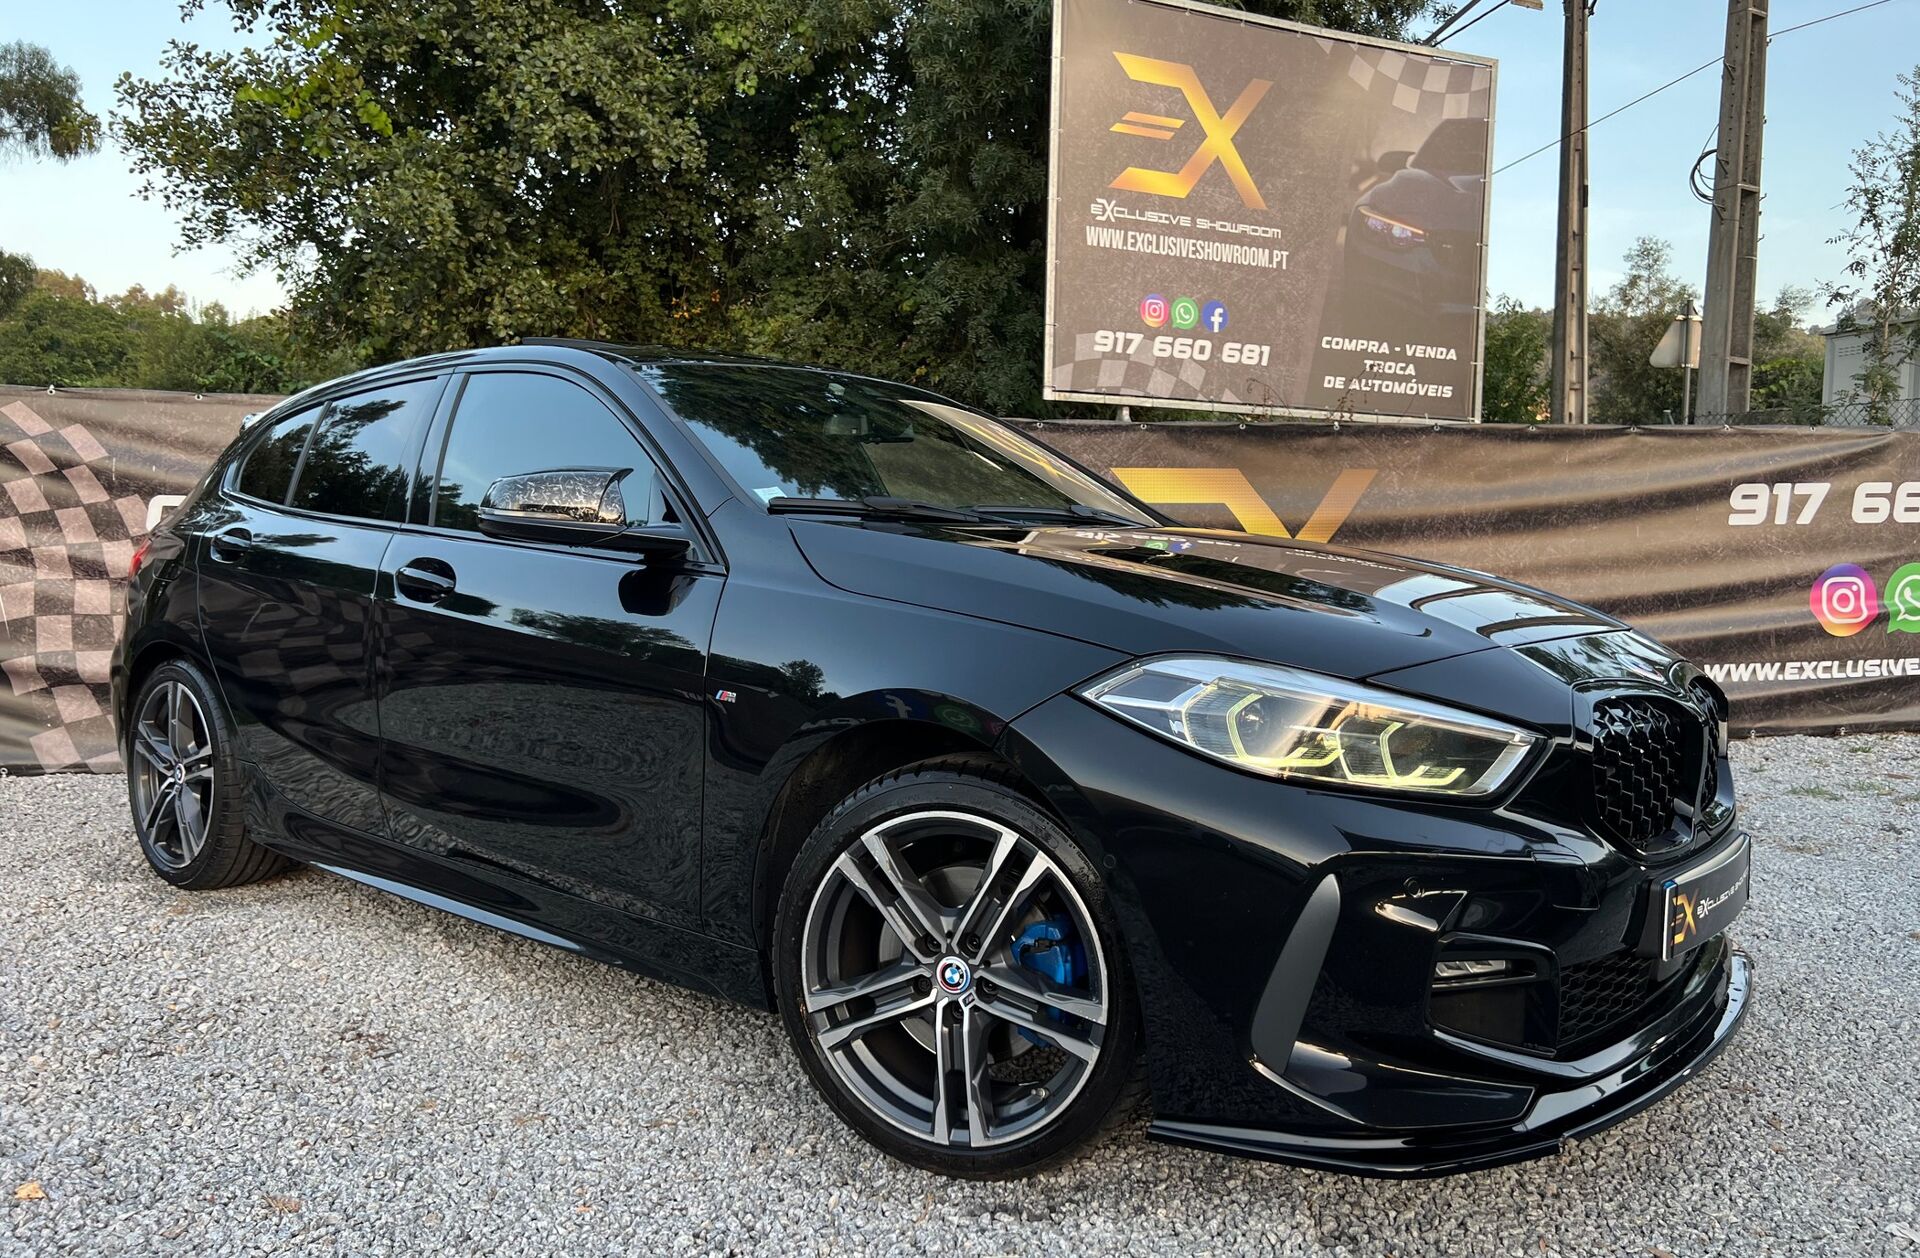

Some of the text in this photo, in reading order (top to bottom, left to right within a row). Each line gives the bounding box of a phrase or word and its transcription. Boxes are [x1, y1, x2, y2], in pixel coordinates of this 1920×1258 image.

[1090, 198, 1281, 239] EXCLUSIVE SHOWROOM
[1086, 225, 1289, 270] WWW.EXCLUSIVESHOWROOM.PT
[1093, 330, 1271, 366] 917 660 681
[1321, 336, 1390, 354] COMPRA
[1405, 343, 1457, 360] VENDA
[1363, 359, 1416, 376] TROCA
[1323, 375, 1453, 398] DE AUTOMÓVEIS
[1728, 482, 1831, 526] 917
[1703, 657, 1920, 683] WWW.EXCLUSIVE
